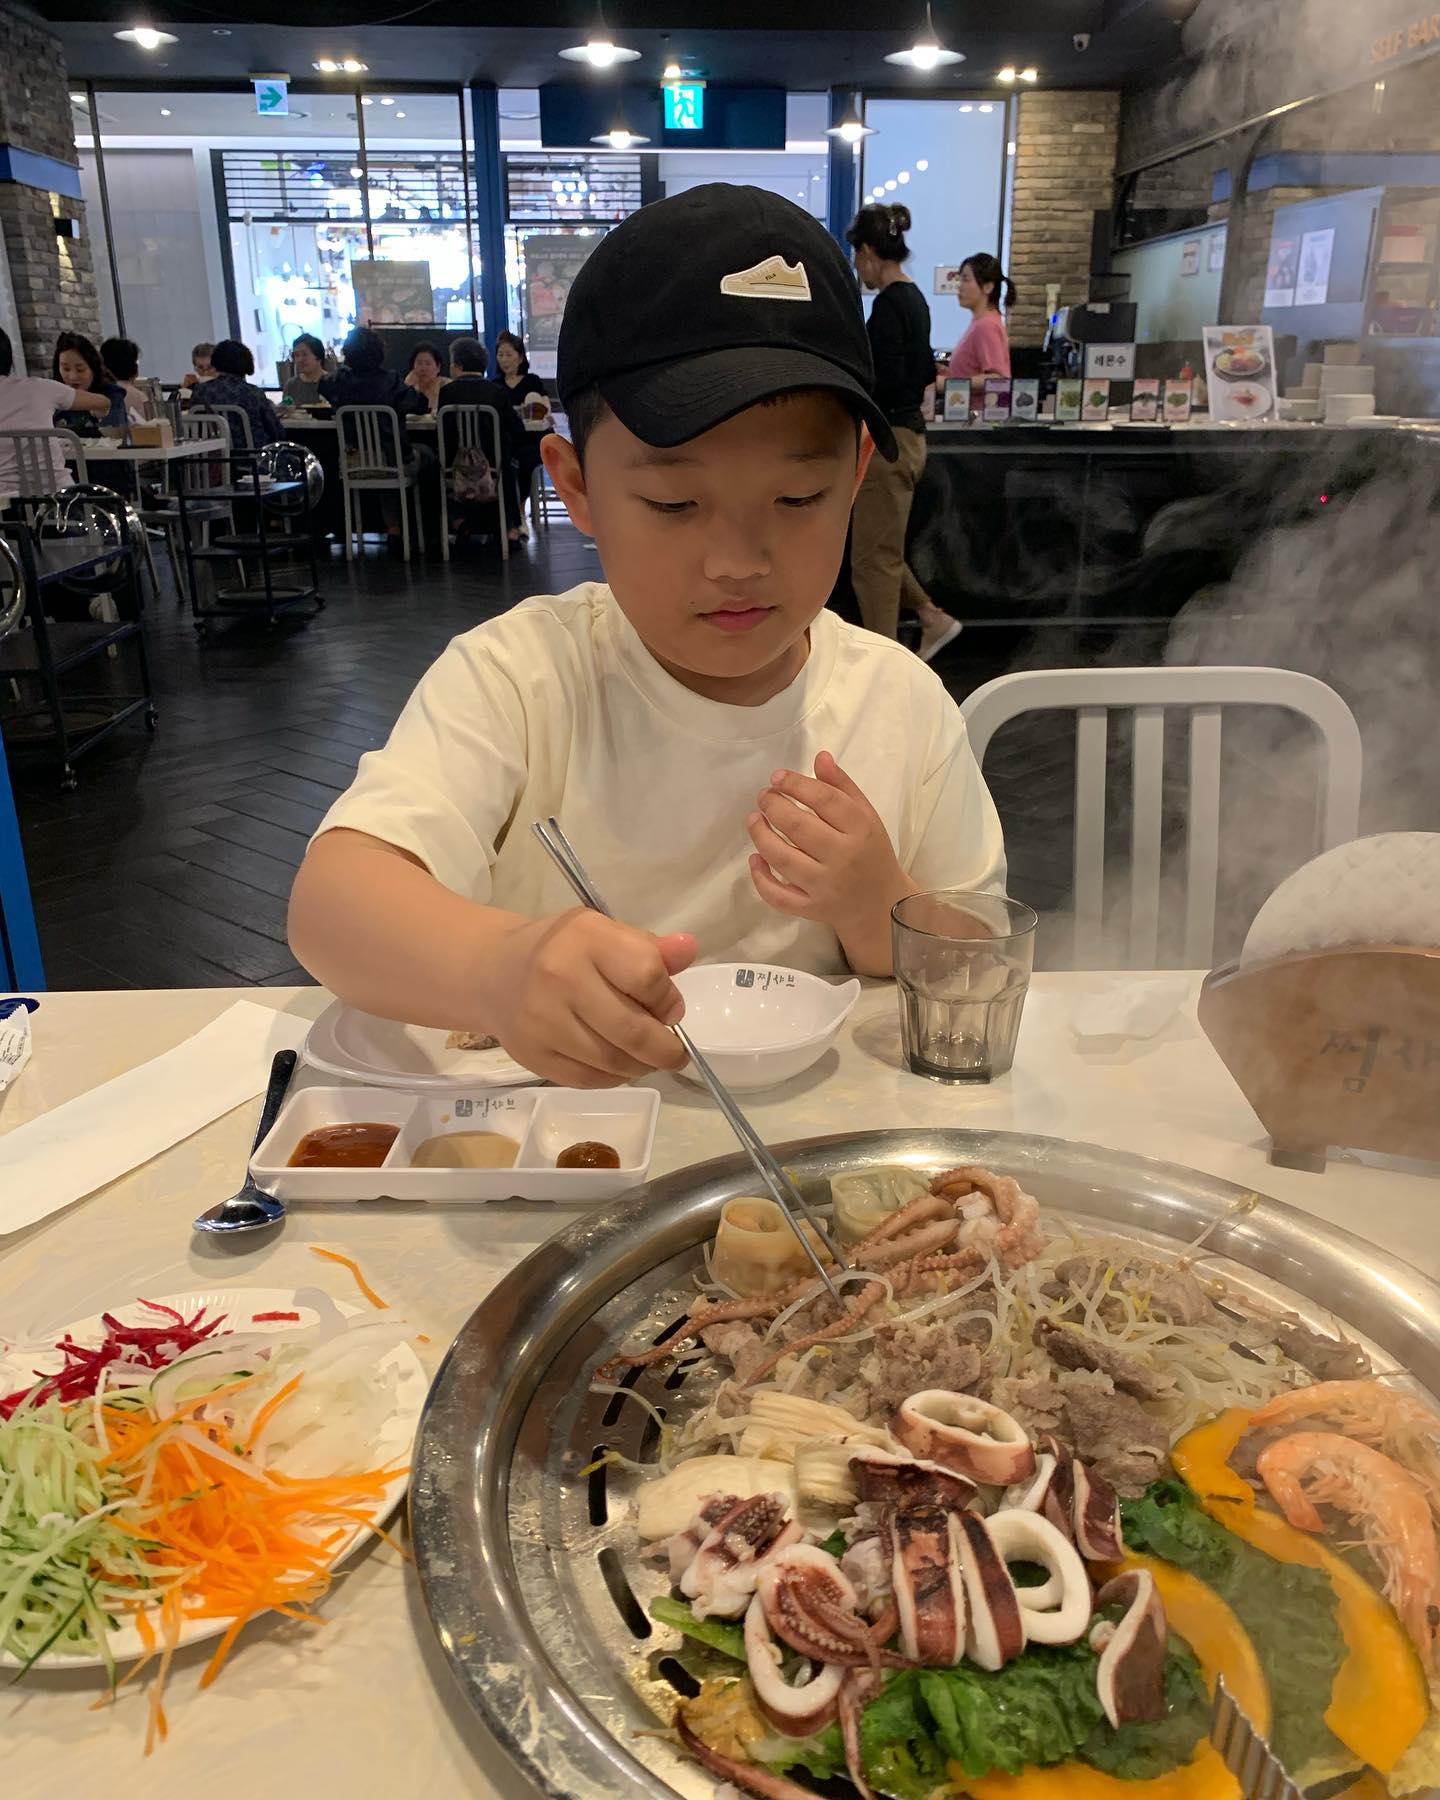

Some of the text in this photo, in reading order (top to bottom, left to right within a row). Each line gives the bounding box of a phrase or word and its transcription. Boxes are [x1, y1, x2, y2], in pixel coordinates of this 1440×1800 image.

[1371, 15, 1440, 64] SELF BAR
[1094, 354, 1126, 367] 레몬수
